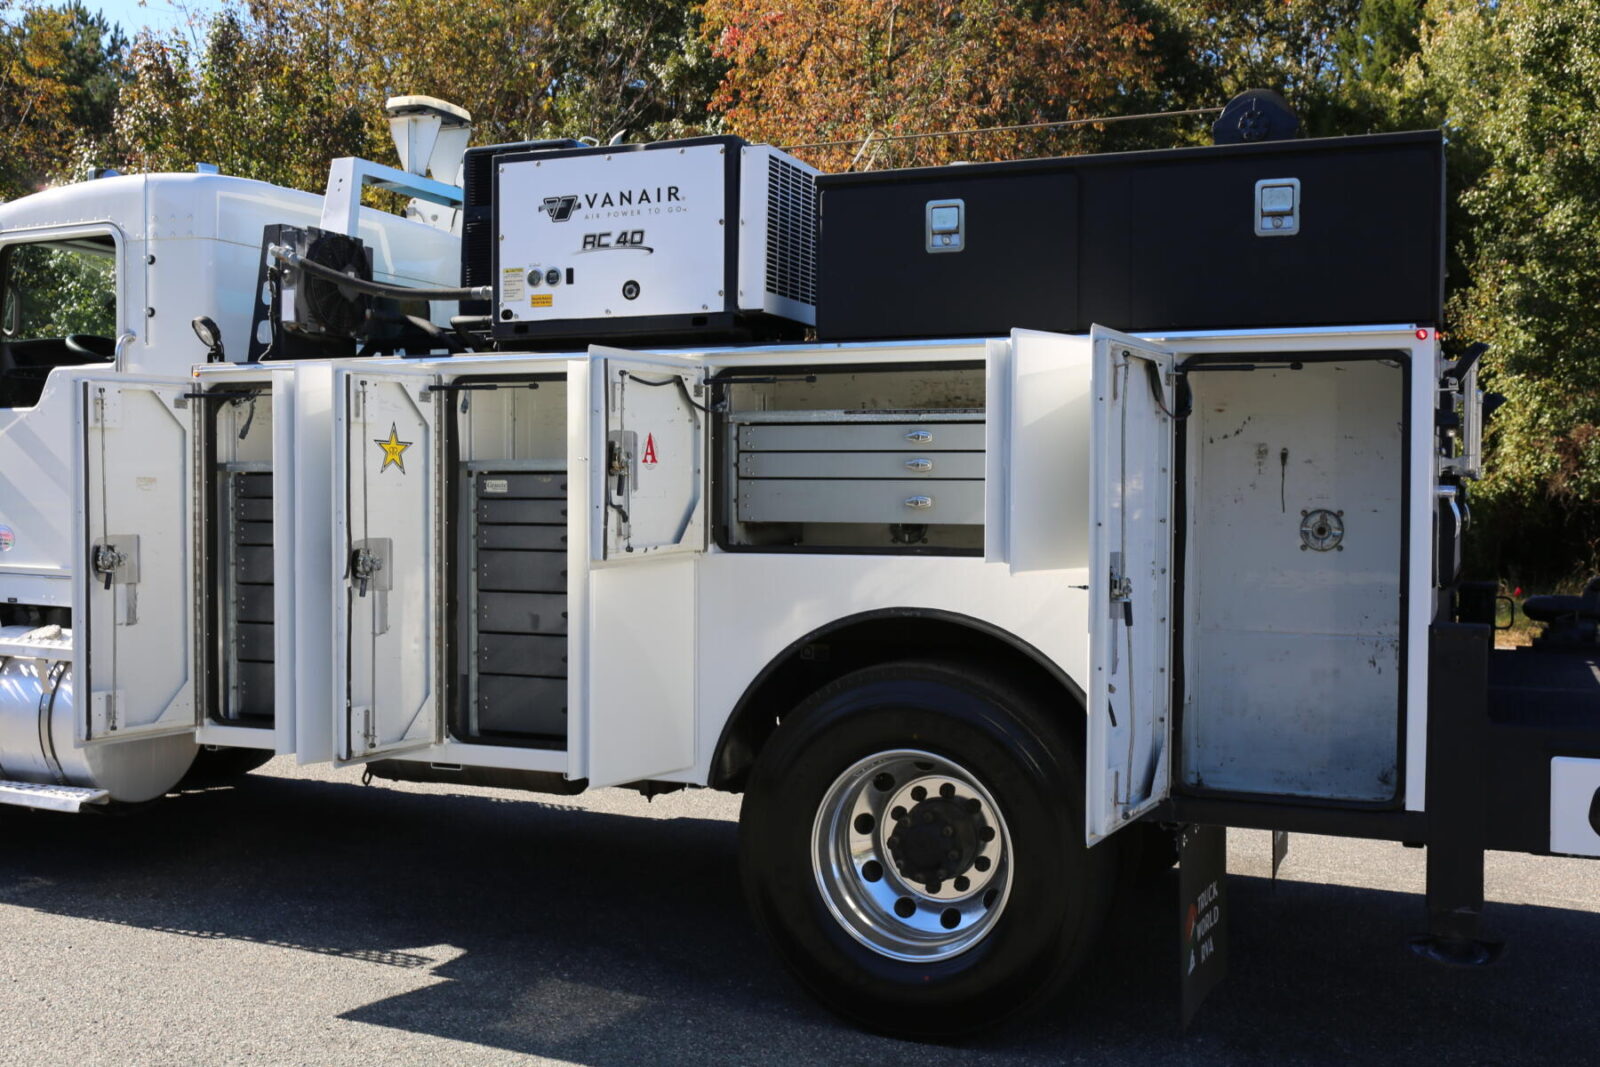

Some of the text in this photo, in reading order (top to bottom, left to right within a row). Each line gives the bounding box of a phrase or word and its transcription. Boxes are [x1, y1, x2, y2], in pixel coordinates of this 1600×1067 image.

[607, 209, 641, 218] POWER
[615, 229, 645, 246] 40
[641, 431, 658, 464] A
[1197, 880, 1218, 915] TRUCK
[1196, 905, 1219, 943] WORLD
